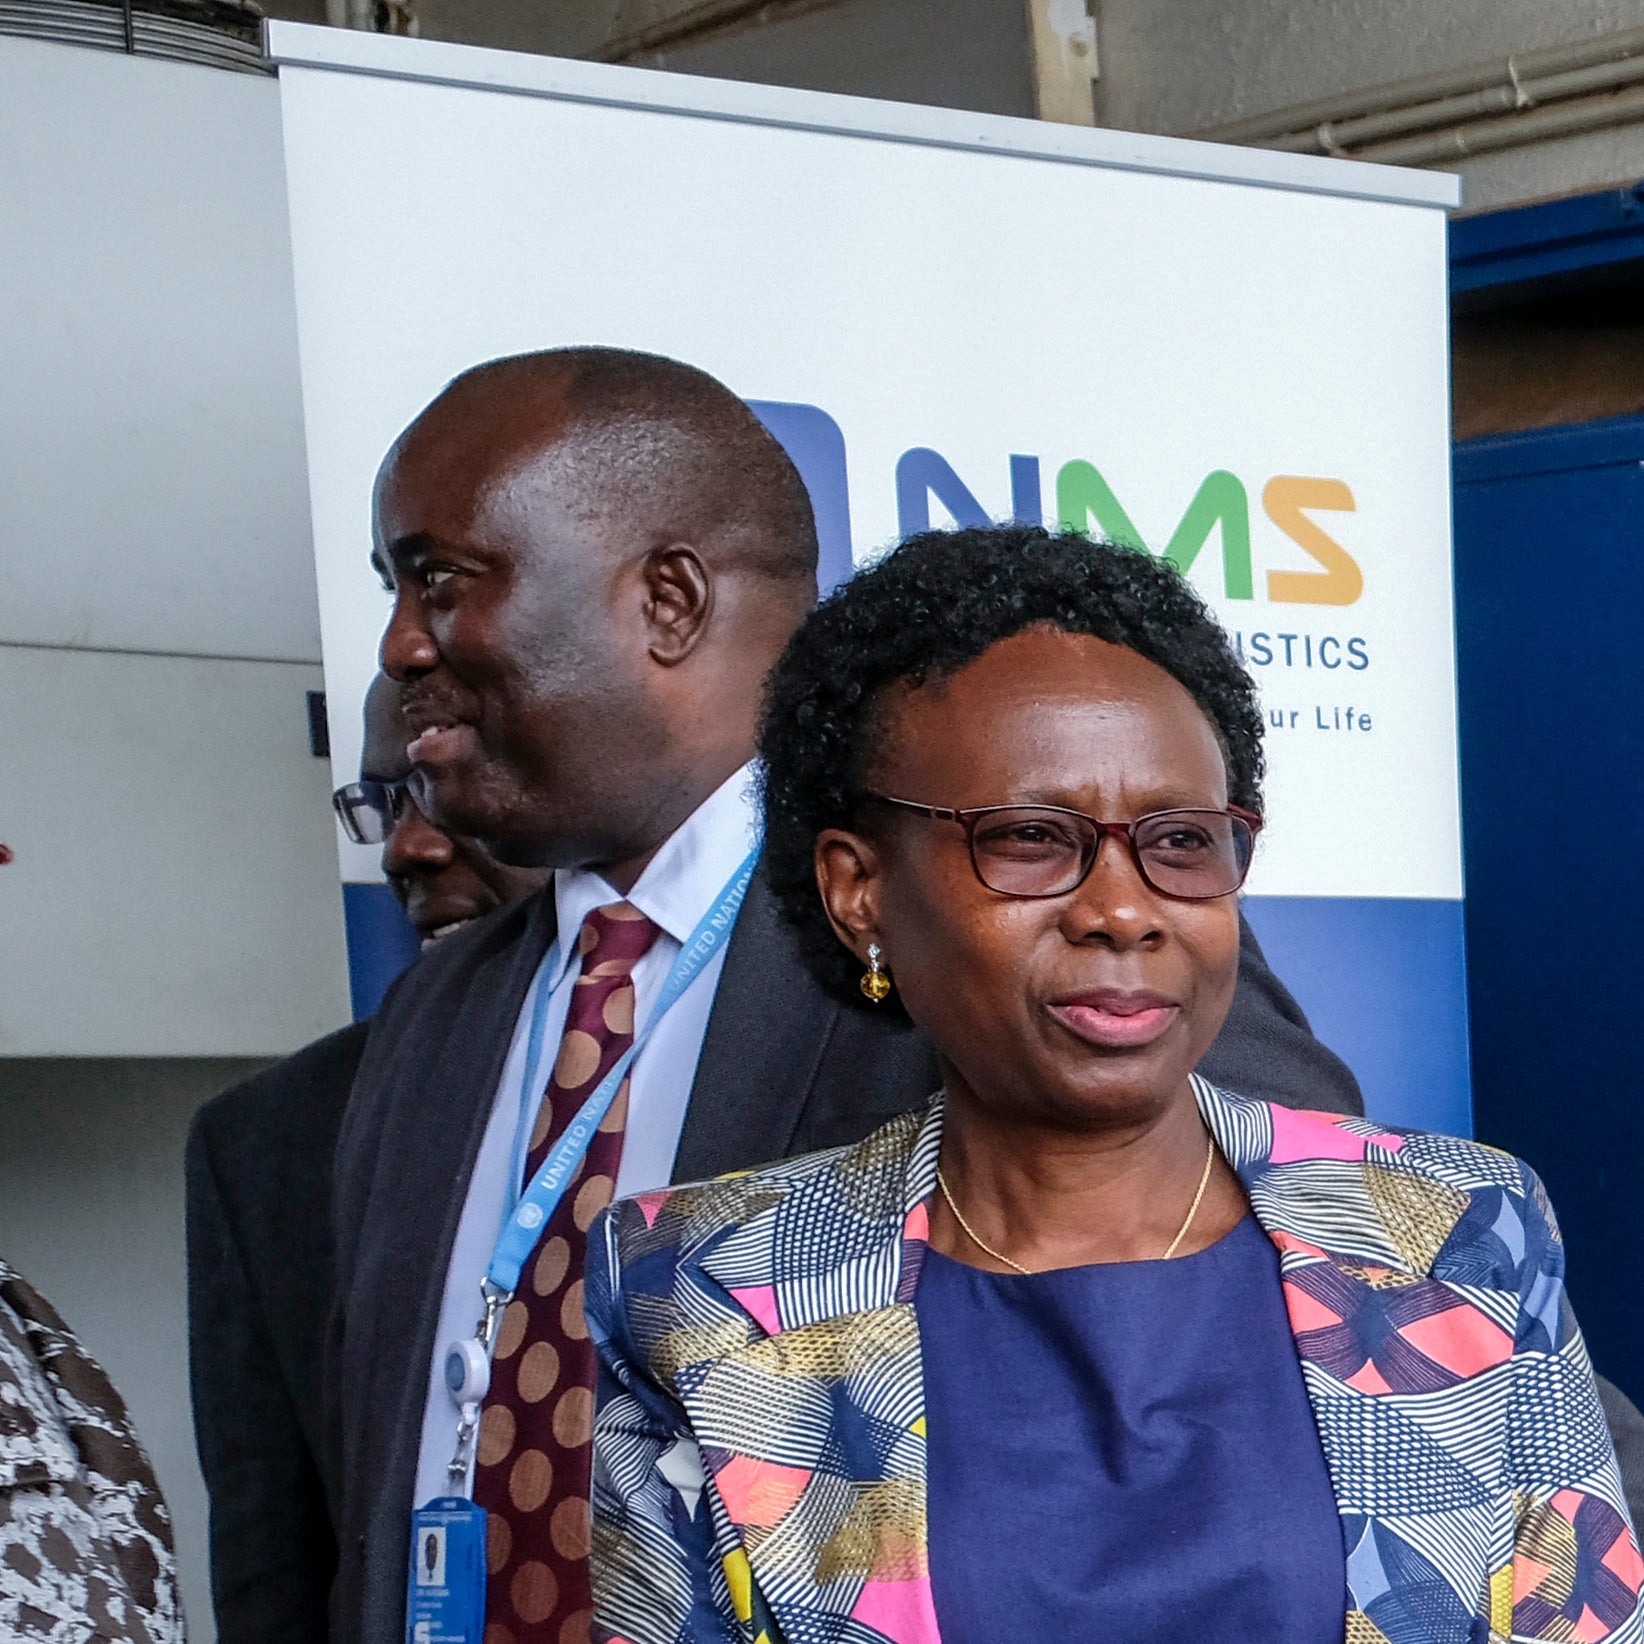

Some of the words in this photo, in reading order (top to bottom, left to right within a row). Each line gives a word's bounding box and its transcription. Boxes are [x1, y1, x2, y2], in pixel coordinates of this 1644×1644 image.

[895, 447, 1364, 607] NMS
[1233, 630, 1370, 671] ISTICS
[1267, 706, 1299, 729] ur
[1316, 706, 1373, 732] Life
[541, 1125, 587, 1190] UNITED
